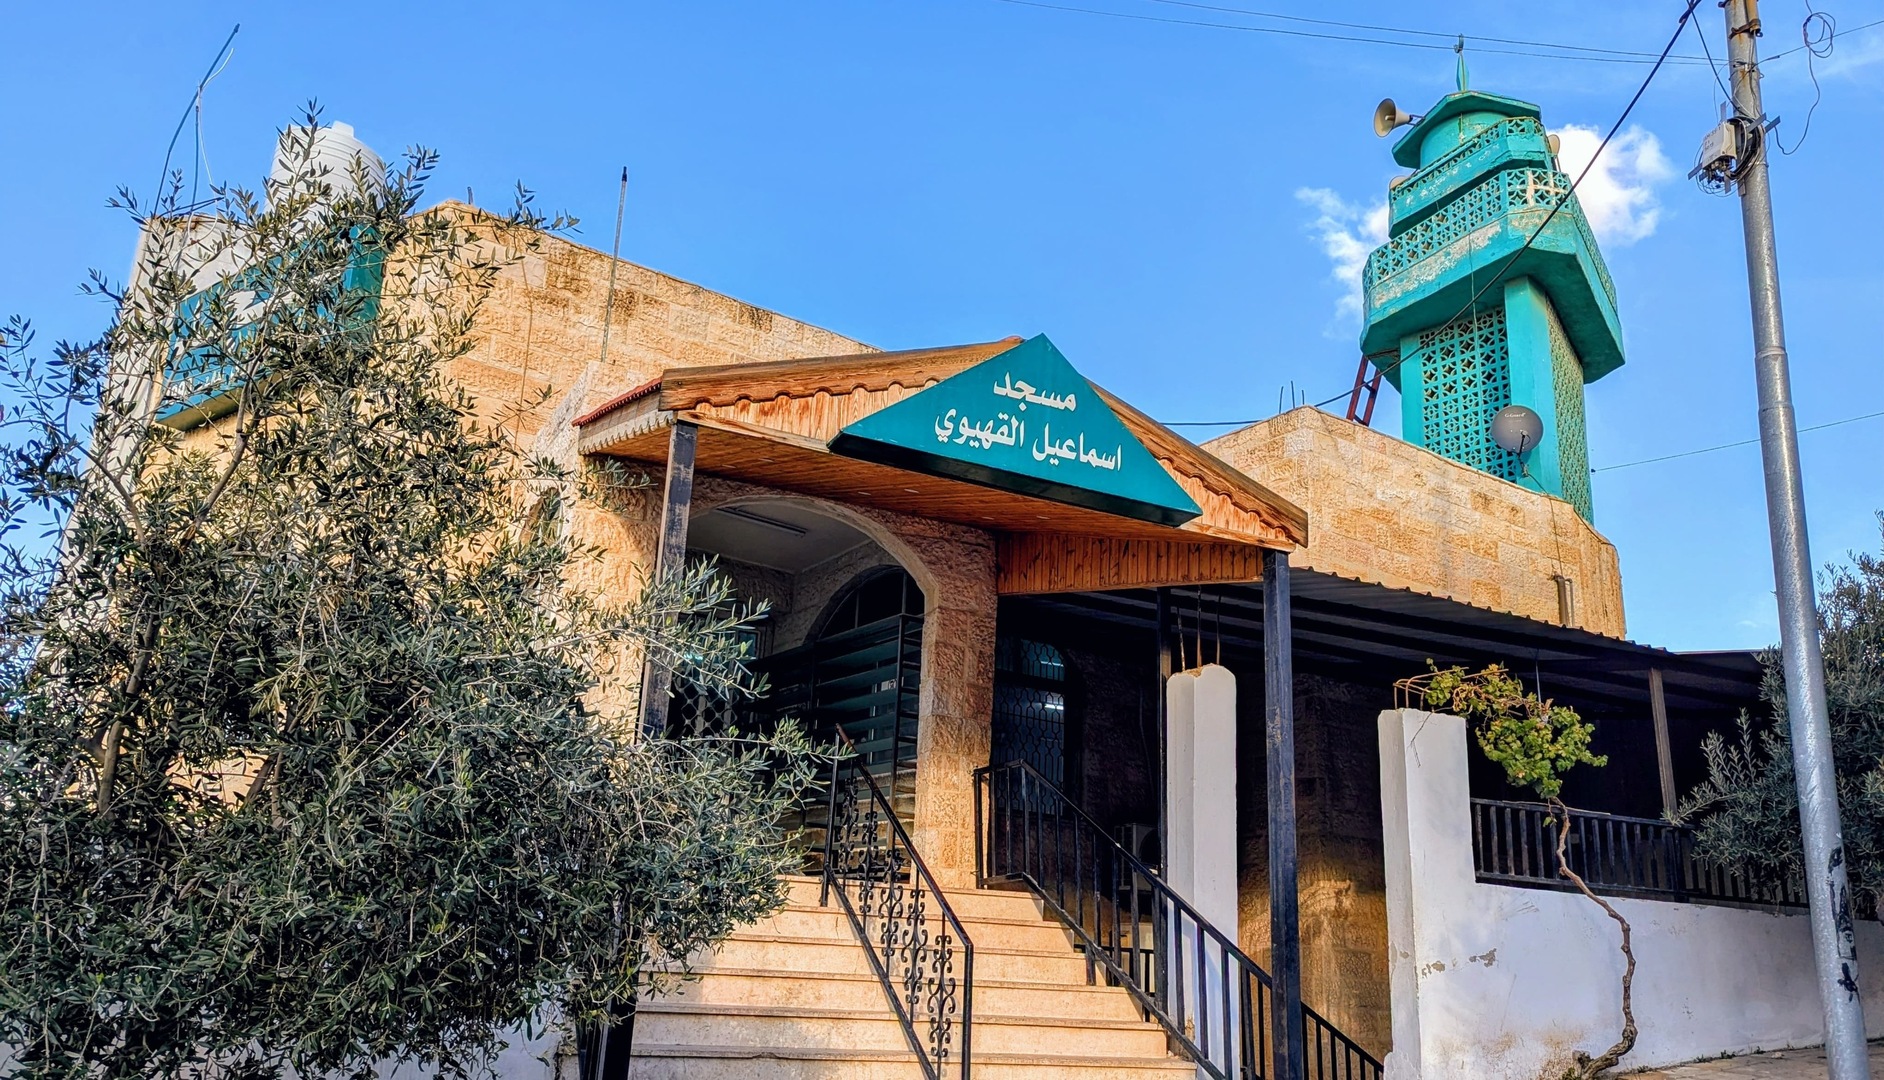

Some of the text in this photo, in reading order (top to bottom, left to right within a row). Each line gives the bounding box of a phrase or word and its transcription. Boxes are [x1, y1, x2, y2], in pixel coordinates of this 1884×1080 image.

[994, 373, 1076, 411] مسجد
[935, 408, 1122, 470] اسماعيل القهيوي
